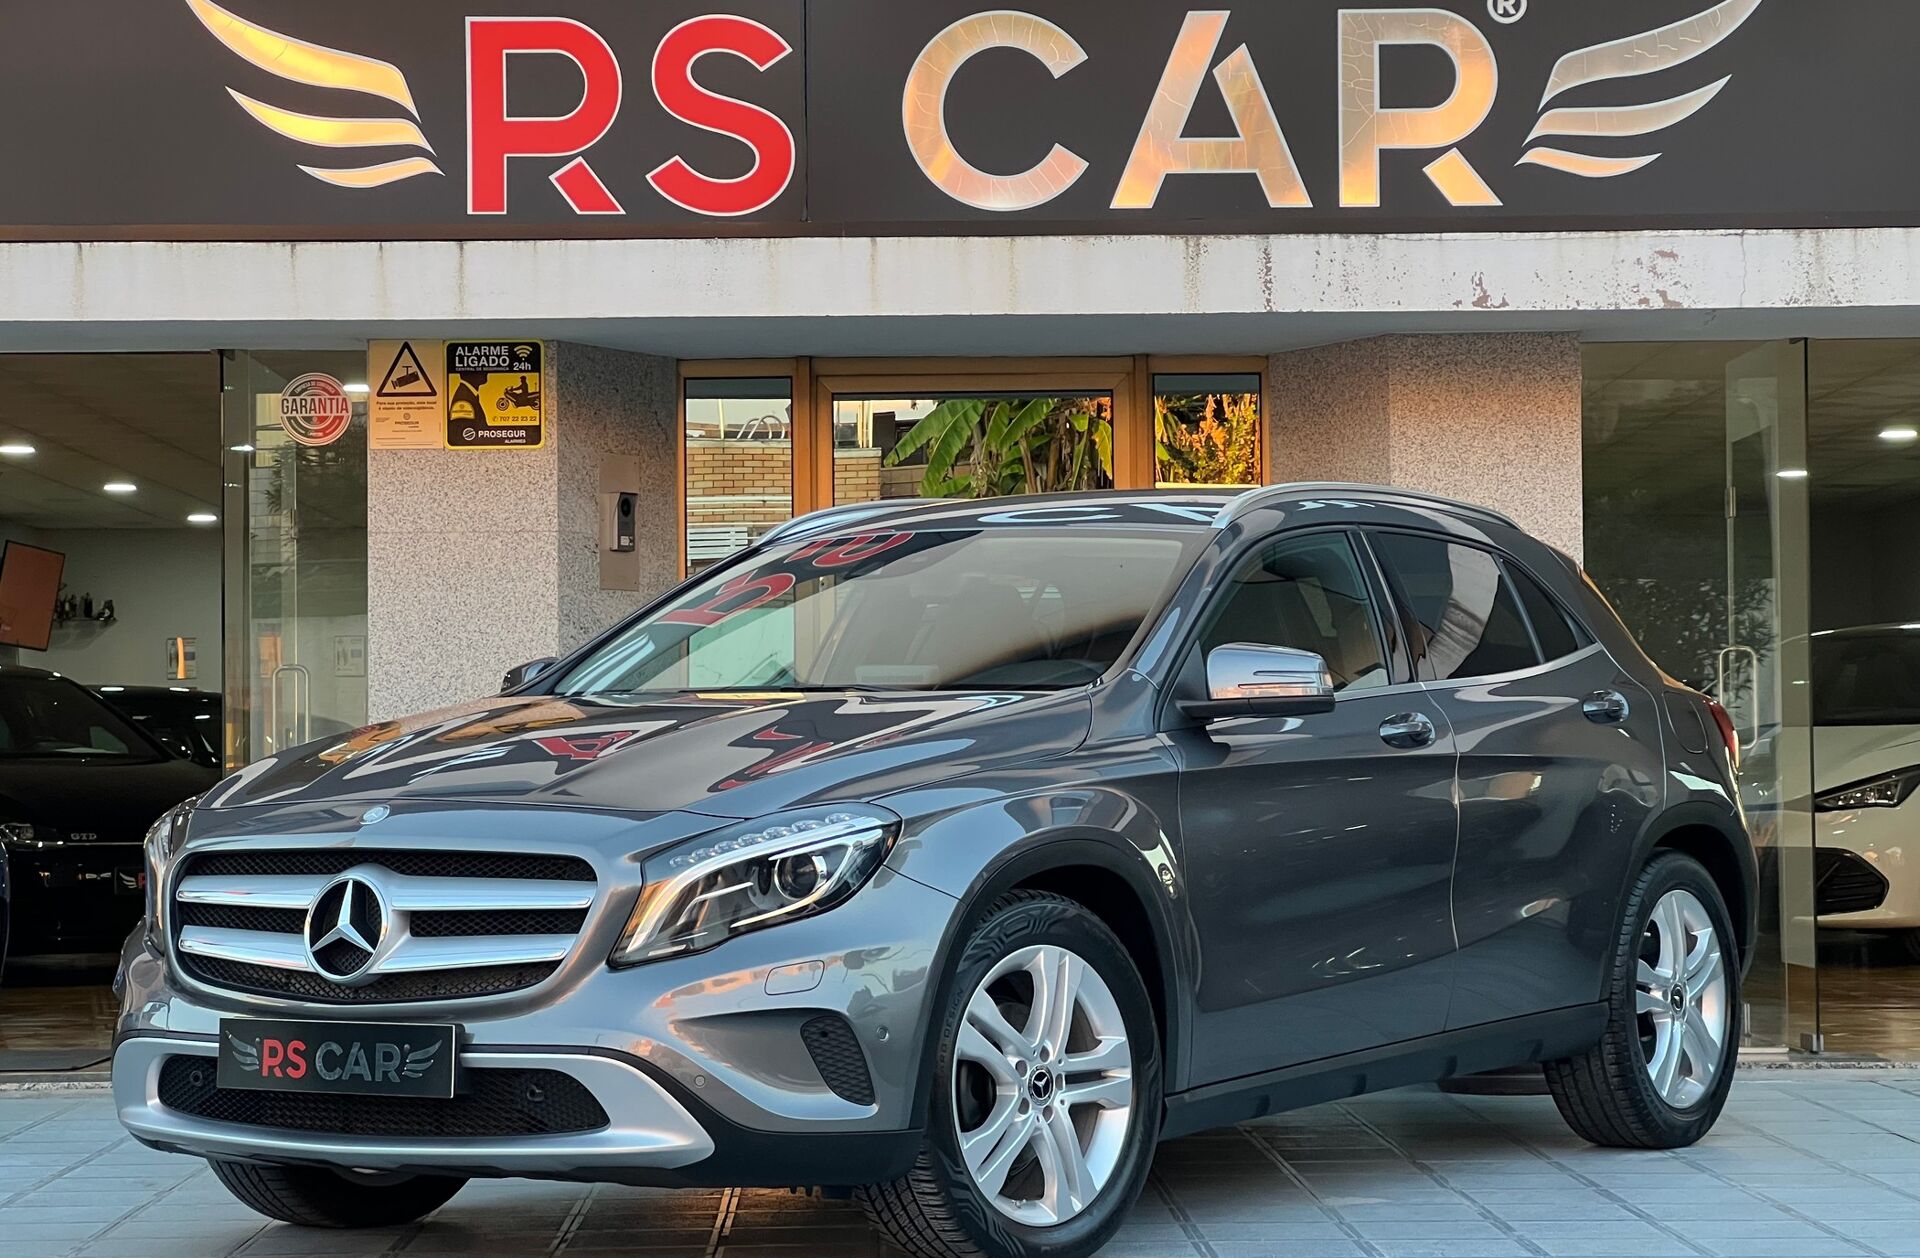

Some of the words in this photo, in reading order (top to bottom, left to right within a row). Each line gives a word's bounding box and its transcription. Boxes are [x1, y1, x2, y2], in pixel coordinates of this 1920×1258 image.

[465, 14, 796, 217] RS
[902, 9, 1504, 212] CAR
[455, 345, 509, 356] ALARME
[455, 356, 510, 367] LIGADO
[513, 362, 532, 371] 24h
[281, 397, 349, 415] GARANTIA
[478, 430, 526, 438] PROSEGUR
[70, 833, 97, 841] GTD
[261, 1039, 307, 1080] RS
[315, 1041, 401, 1083] CAR
